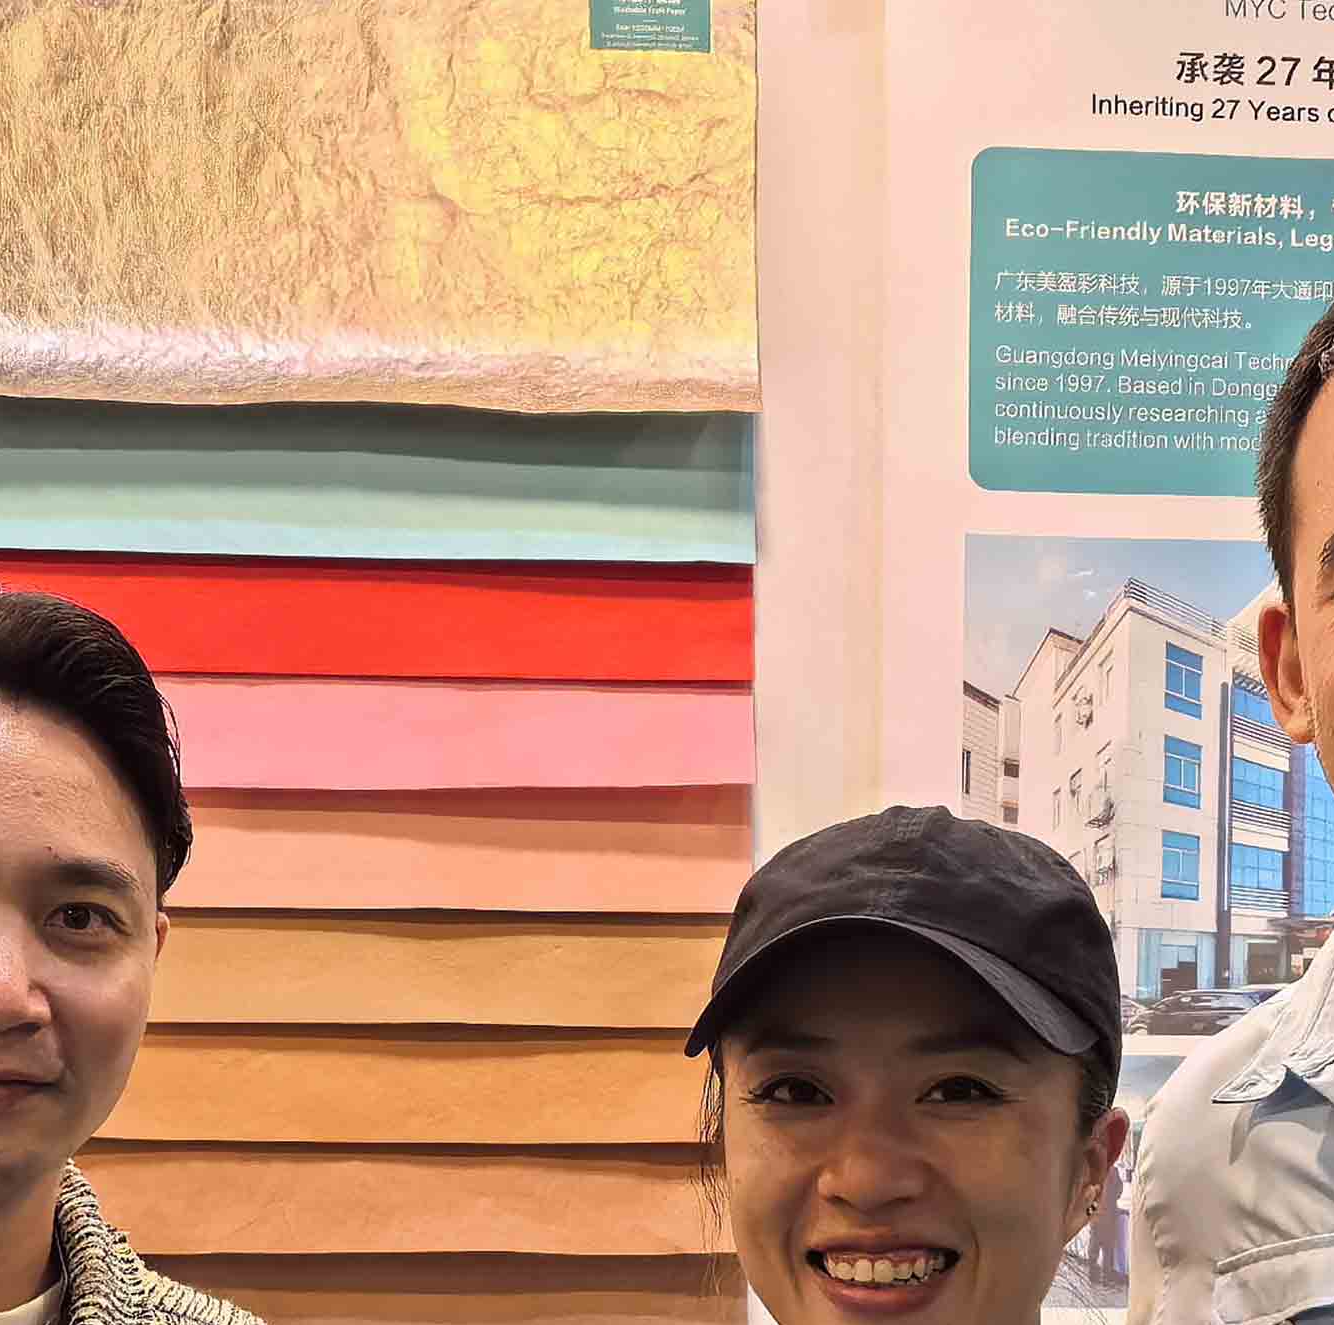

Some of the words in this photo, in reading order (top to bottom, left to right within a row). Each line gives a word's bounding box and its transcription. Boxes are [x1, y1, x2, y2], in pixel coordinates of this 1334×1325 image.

[1224, 0, 1287, 19] MYC
[1175, 51, 1244, 86] 承袭
[1255, 56, 1301, 87] 27
[1091, 93, 1204, 122] Inheriting
[1210, 98, 1240, 121] 27
[1248, 100, 1320, 124] Years
[1005, 217, 1164, 246] Eco-Friendly
[1167, 222, 1284, 251] Materials,
[995, 344, 1114, 369] Guangdong
[1235, 351, 1295, 371] Techn
[994, 373, 1049, 392] since
[1056, 375, 1111, 393] 1997.
[1118, 376, 1182, 396] Based
[1188, 377, 1205, 396] in
[1212, 378, 1280, 401] Dongg
[994, 400, 1122, 425] continuously
[1128, 404, 1249, 427] researching
[994, 425, 1080, 450] blending
[1086, 429, 1168, 449] tradition
[1173, 431, 1214, 450] with
[1220, 432, 1264, 451] mod
